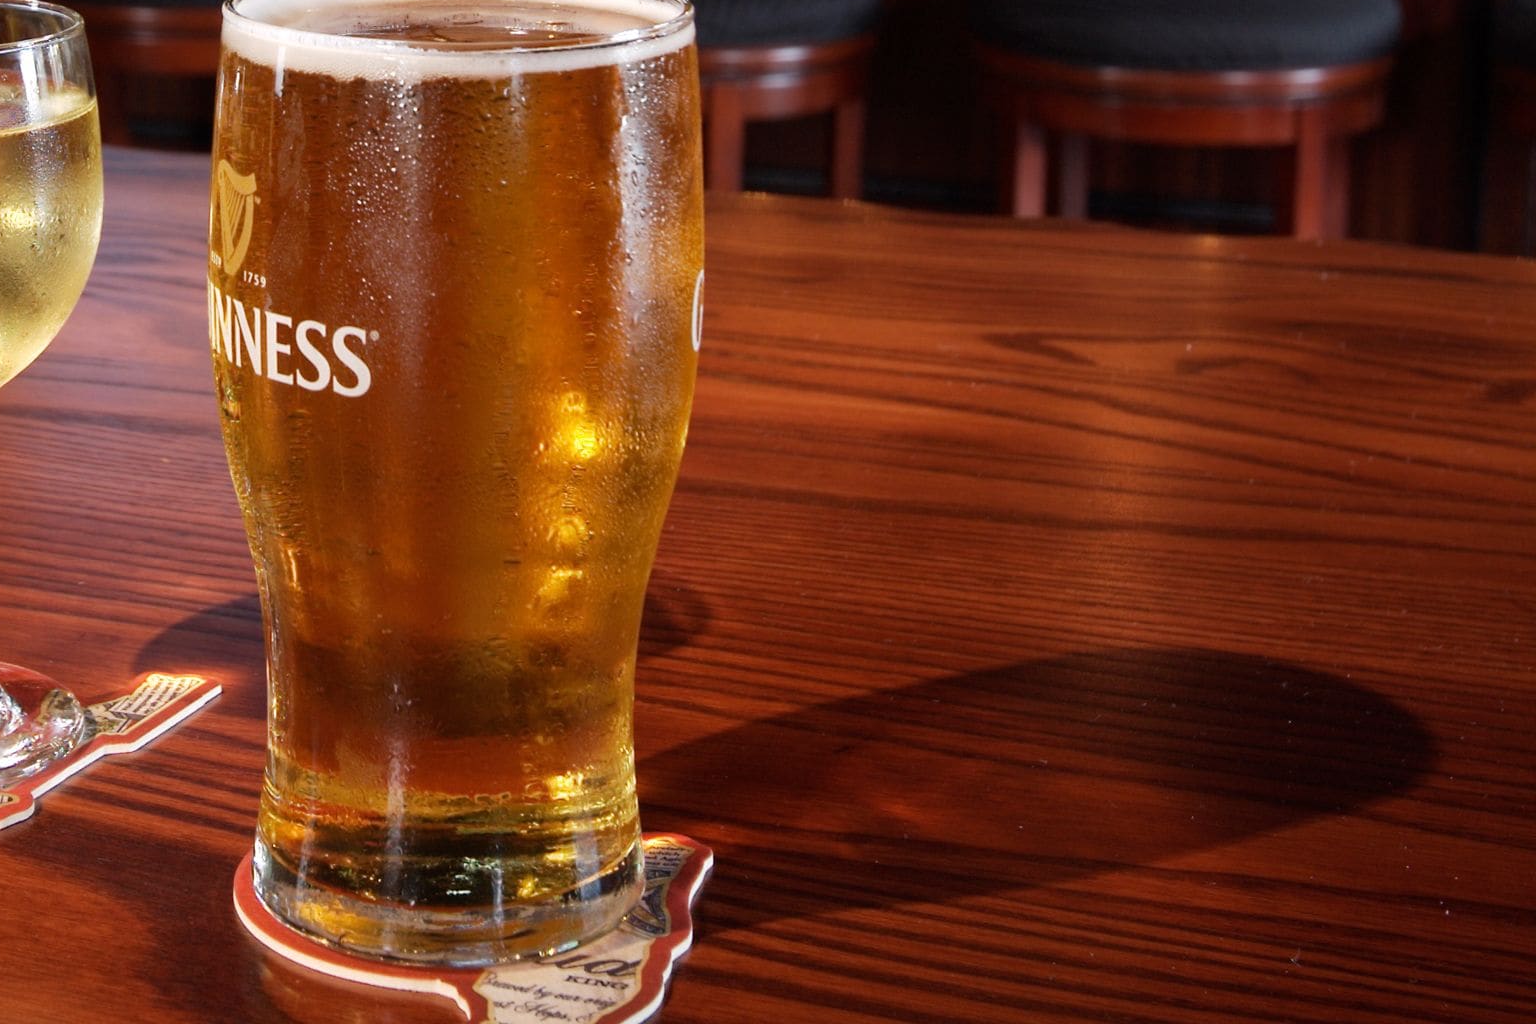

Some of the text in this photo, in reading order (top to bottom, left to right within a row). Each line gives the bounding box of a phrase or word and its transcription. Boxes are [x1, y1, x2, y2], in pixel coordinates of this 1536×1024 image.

[243, 270, 267, 289] 1759
[207, 276, 372, 398] INNESS
[565, 975, 629, 990] KING
